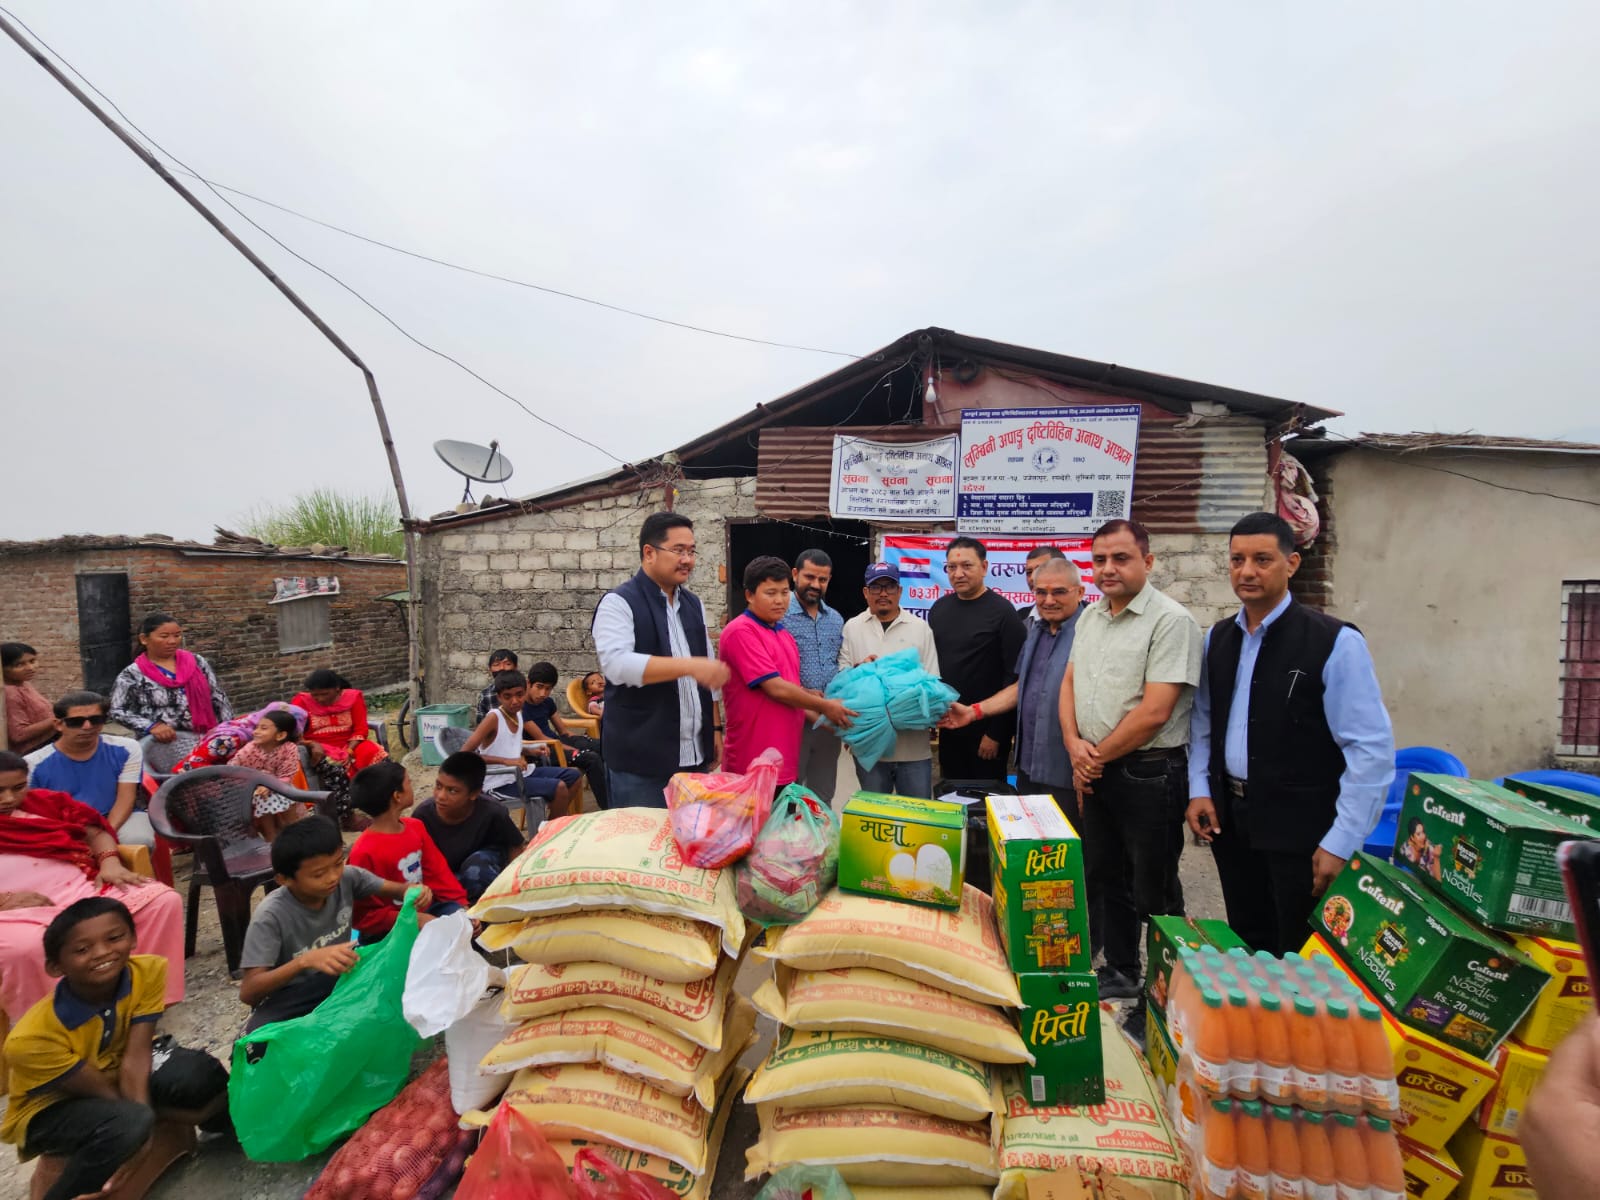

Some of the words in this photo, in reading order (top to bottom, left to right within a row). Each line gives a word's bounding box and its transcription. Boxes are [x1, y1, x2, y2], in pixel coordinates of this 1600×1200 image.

[1074, 428, 1104, 450] अनाथ
[1103, 439, 1133, 467] आश्रम
[881, 476, 908, 487] सूचना
[1423, 796, 1466, 826] Current
[860, 819, 916, 848] माया
[1025, 843, 1068, 877] प्रिती
[1358, 875, 1404, 915] Current
[1442, 868, 1482, 903] Noodles
[1357, 946, 1396, 991] Noodles
[1467, 960, 1509, 981] Current
[1449, 975, 1498, 1003] Noodles
[1030, 1002, 1090, 1046] प्रिती
[1453, 1000, 1468, 1012] 20
[1467, 1009, 1490, 1023] only
[1405, 1072, 1458, 1097] करेन्ट
[1099, 1137, 1142, 1148] PROTEIN
[1119, 1129, 1144, 1138] SOYA
[1145, 1140, 1170, 1152] HIGH
